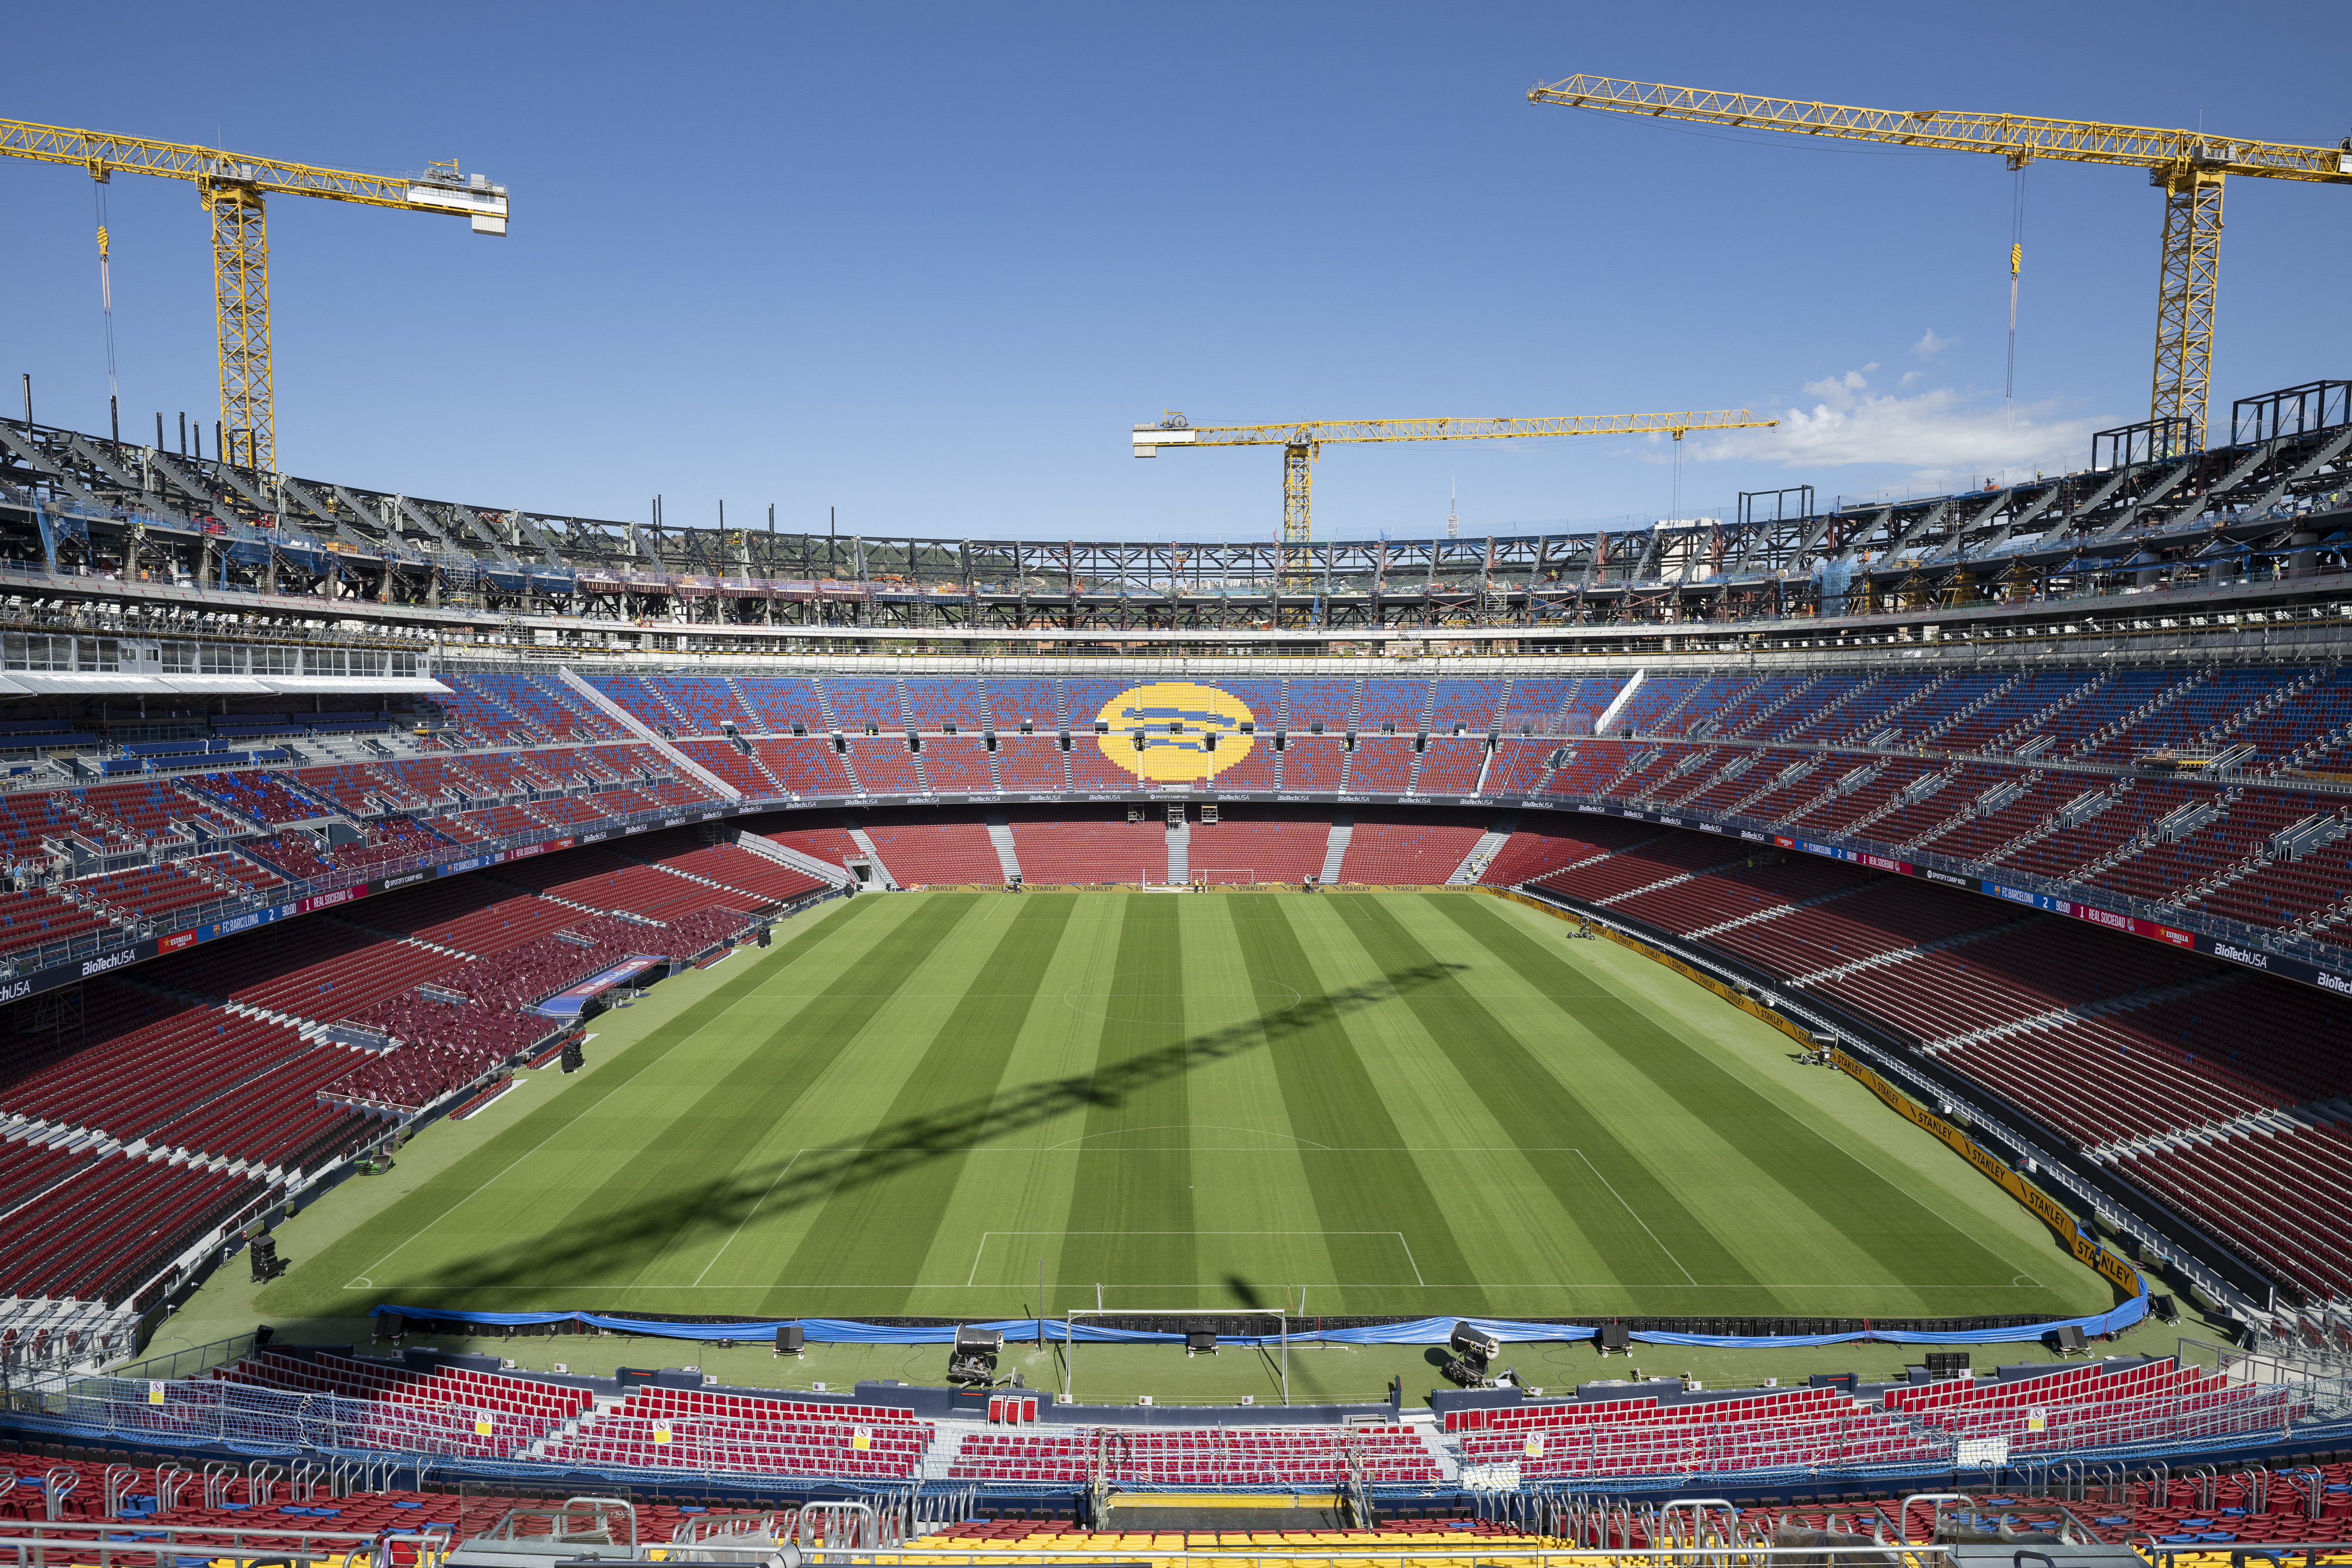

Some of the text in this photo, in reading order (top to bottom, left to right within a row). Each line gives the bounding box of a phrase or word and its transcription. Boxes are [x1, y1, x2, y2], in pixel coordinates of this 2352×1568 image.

[703, 810, 722, 820] BioTechUSA
[739, 805, 762, 814] BioTechUSA
[1623, 810, 1643, 819] BioTechUSA
[665, 817, 685, 827] BioTechUSA
[1661, 816, 1681, 825] BioTechUSA
[626, 824, 647, 834] BioTechUSA
[1700, 823, 1722, 833] BioTechUSA
[584, 831, 607, 843] BioTechUSA
[1741, 830, 1764, 841] BioTechUSA
[453, 864, 458, 872] FC
[459, 858, 479, 871] BARCELONA
[486, 856, 489, 865] 2
[495, 853, 505, 862] 90:00
[511, 851, 514, 859] 1
[524, 845, 539, 855] SOCIEDAD
[1813, 844, 1831, 855] BARCELONA
[1838, 850, 1842, 858] 2
[1847, 851, 1856, 861] 90:00
[1863, 855, 1866, 864] 1
[1869, 855, 1877, 865] REAL
[1877, 857, 1894, 870] SOCIEDAD
[390, 877, 404, 887] SPOTIFY
[405, 875, 415, 884] CAMP
[1932, 872, 1946, 881] SPOTIFY
[1494, 889, 1508, 898] STANLEY
[1520, 897, 1535, 907] STANLEY
[2002, 887, 2125, 928] FC BARCELONA 2 90:00 1 REAL SOCIEDAD
[223, 890, 346, 933] FC BARCELONA 2 90:00 1 REAL SOCIEDAD
[1544, 905, 1557, 915] STANLEY
[1592, 925, 1607, 936] STANLEY
[2166, 931, 2188, 942] ESTRELLA
[171, 934, 192, 946] ESTRELLA
[1618, 935, 1633, 947] STANLEY
[1645, 948, 1661, 960] STANLEY
[2215, 942, 2267, 968] BioTechUSA
[82, 948, 135, 975] BioTechUSA
[1672, 961, 1688, 974] STANLEY
[1699, 975, 1716, 990] STANLEY
[1728, 991, 1745, 1007] STANLEY
[1761, 1009, 1783, 1028] STANLEY
[1838, 1055, 1862, 1076] STANLEY
[1877, 1082, 1899, 1105] STANLEY
[1919, 1112, 1952, 1140] STANLEY
[1972, 1149, 2005, 1181] STANLEY
[2029, 1192, 2064, 1228] STANLEY
